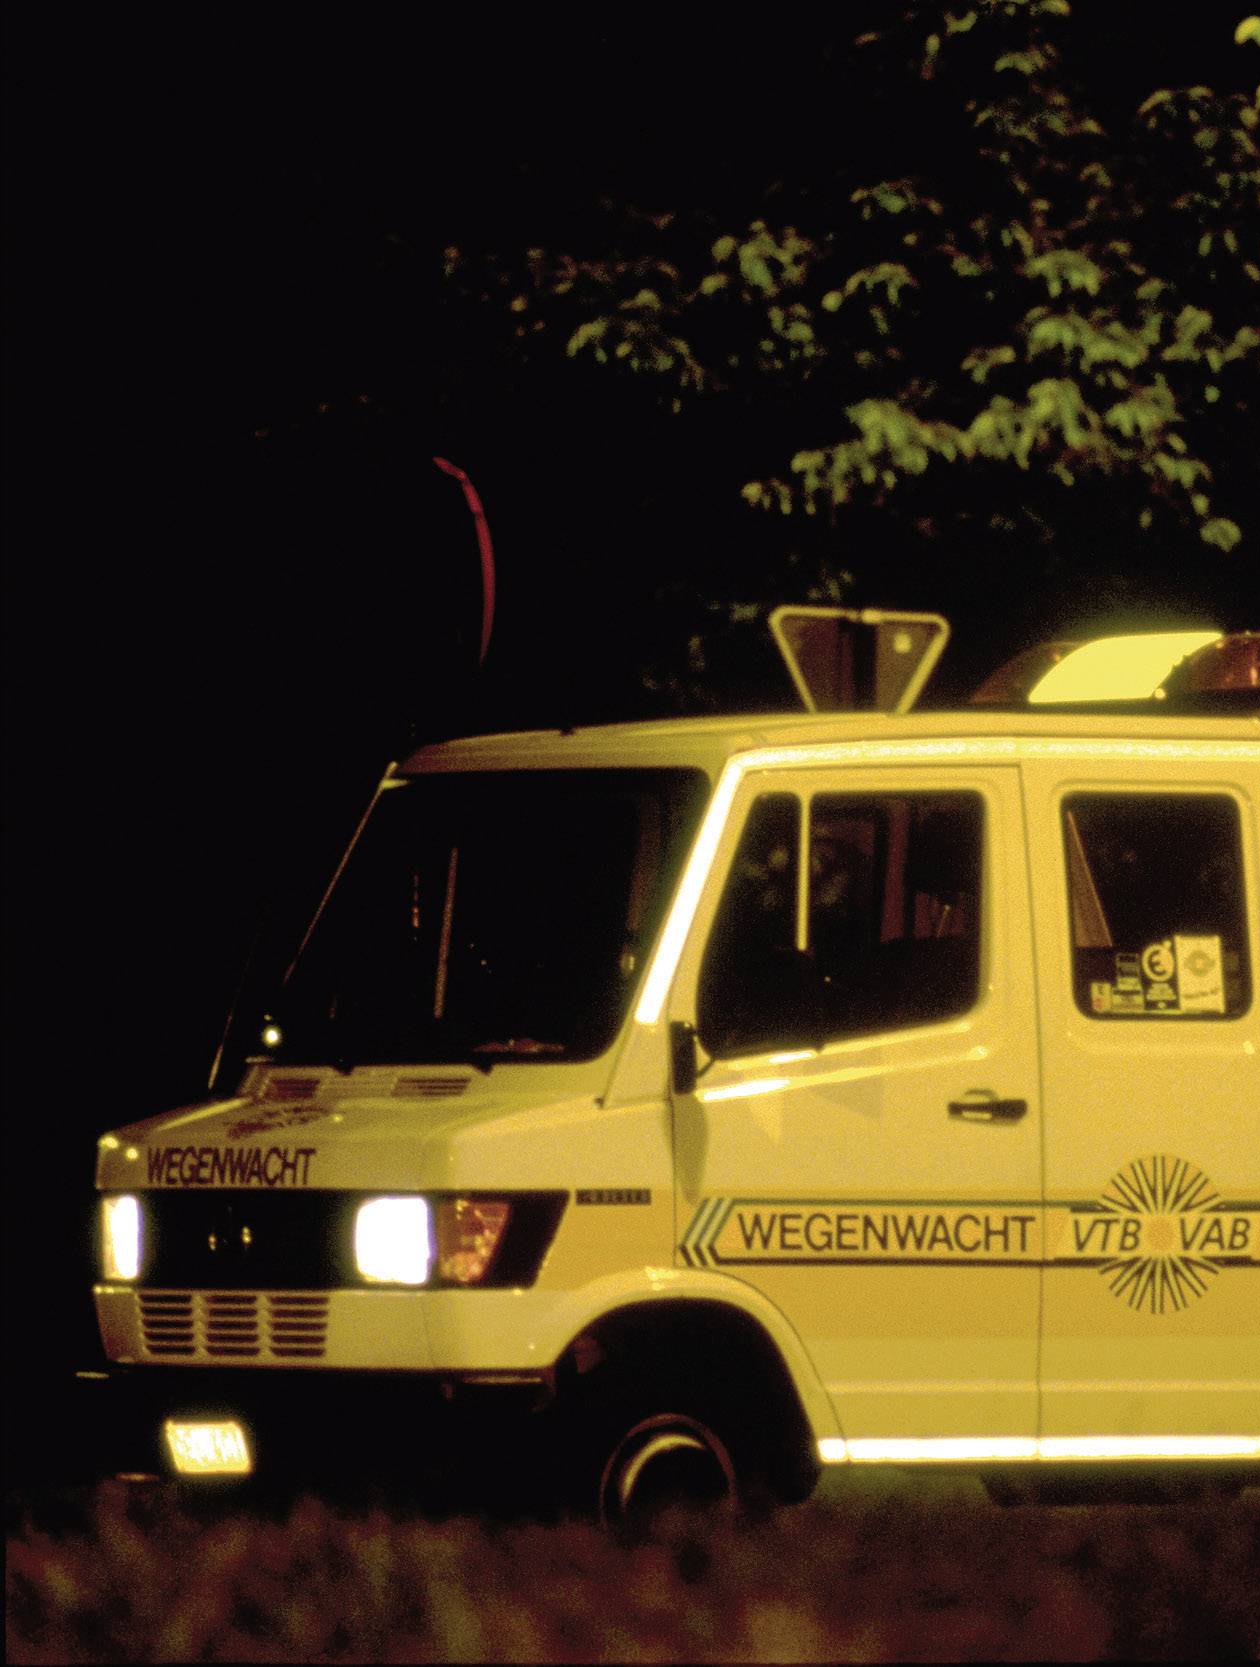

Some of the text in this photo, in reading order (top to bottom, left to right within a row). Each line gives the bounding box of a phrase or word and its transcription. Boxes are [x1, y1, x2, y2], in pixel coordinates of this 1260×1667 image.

[147, 1146, 317, 1186] WEGENWACHT
[737, 1213, 1251, 1252] WEGENWACHT VTB VAB
